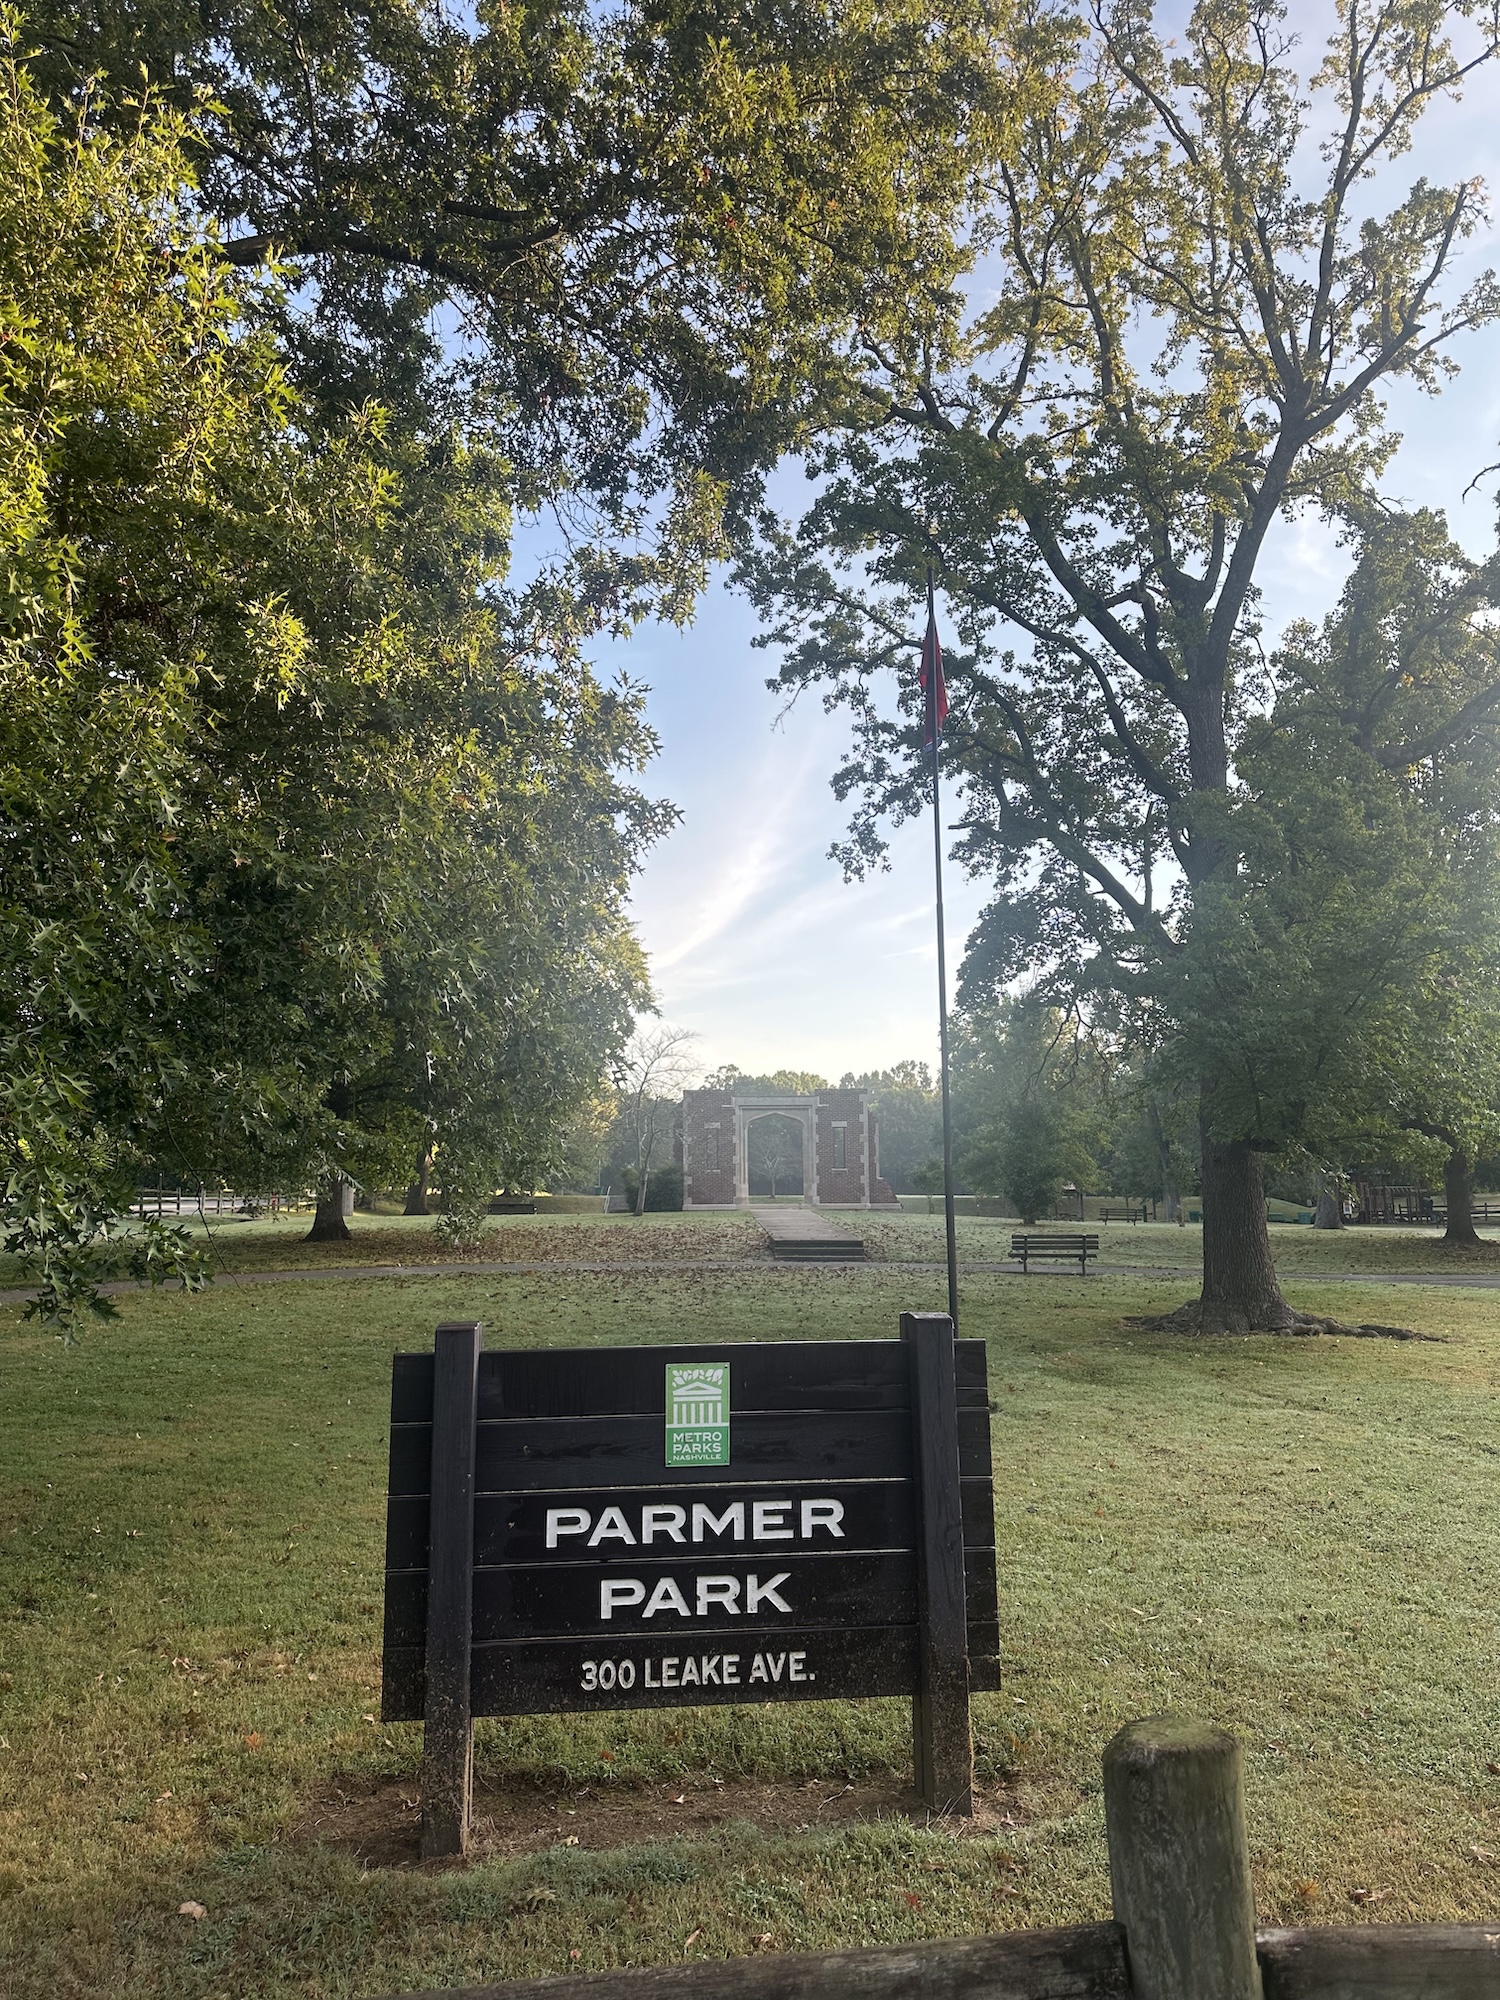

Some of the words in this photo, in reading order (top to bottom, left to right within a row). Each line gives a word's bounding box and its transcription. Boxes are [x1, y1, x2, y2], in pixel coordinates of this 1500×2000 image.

[673, 1431, 722, 1442] METRO
[673, 1442, 721, 1454] PARKS
[545, 1499, 846, 1549] PARMER
[600, 1573, 793, 1620] PARK
[580, 1659, 635, 1691] 300
[645, 1653, 740, 1689] LEAKE
[748, 1651, 817, 1684] AVE.
